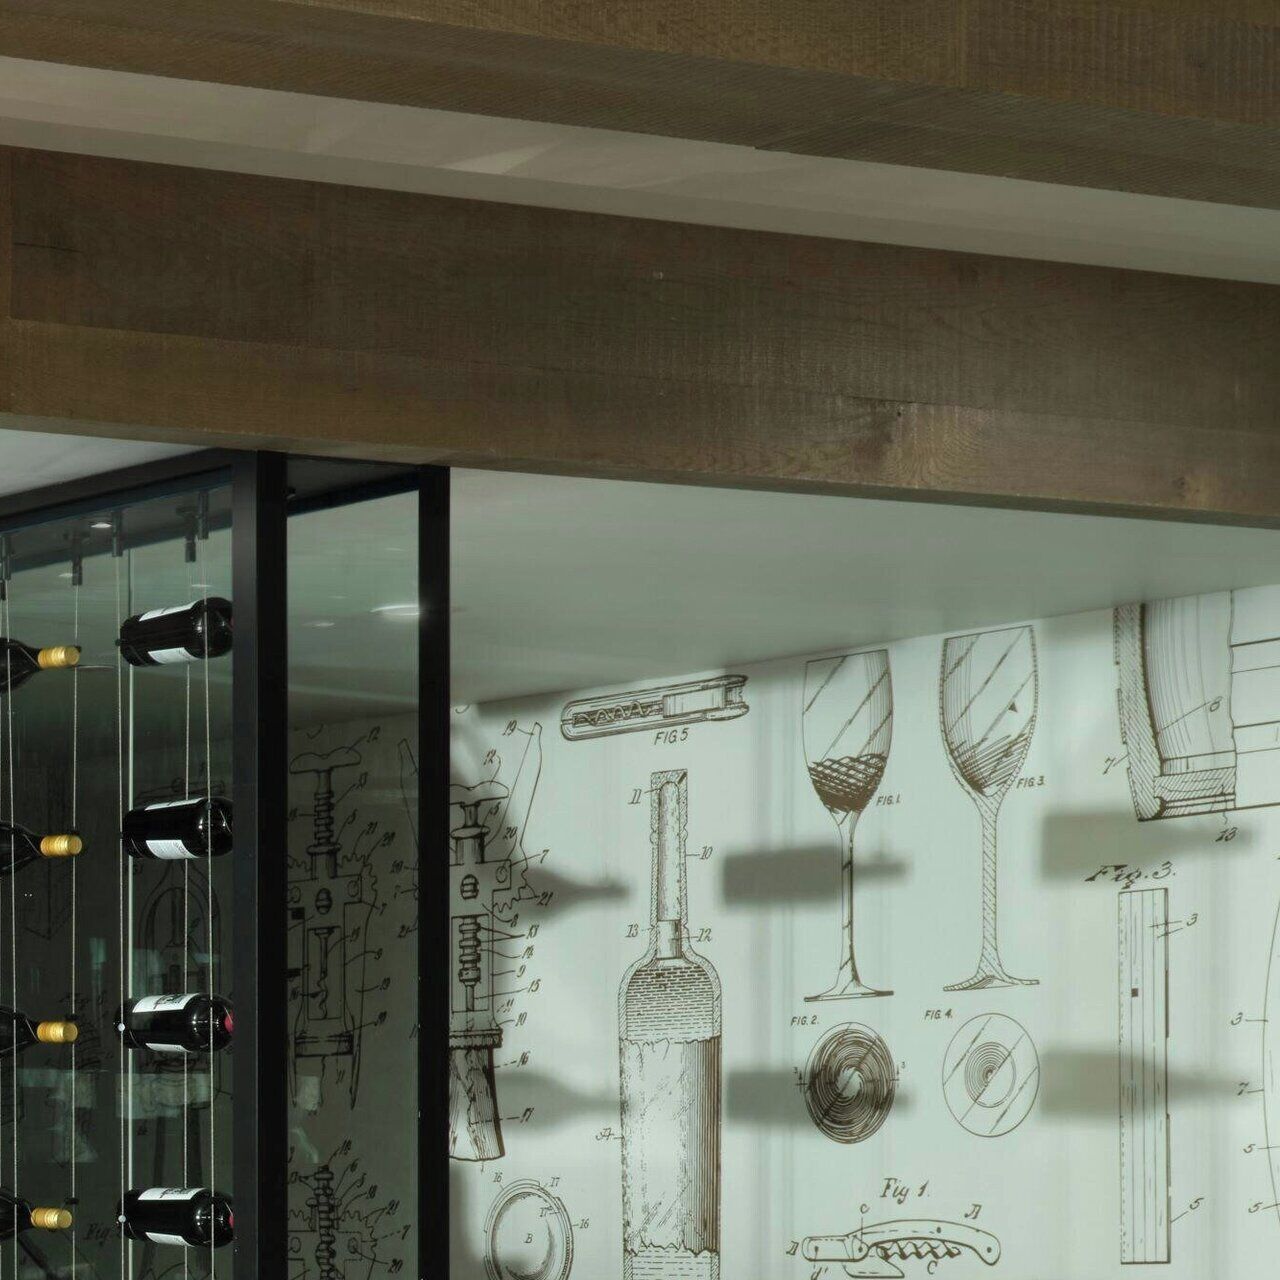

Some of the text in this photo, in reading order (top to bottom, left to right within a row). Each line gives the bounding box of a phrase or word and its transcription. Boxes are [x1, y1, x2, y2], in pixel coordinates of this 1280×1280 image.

[699, 845, 713, 859] 10
[1186, 913, 1199, 926] 3
[625, 924, 639, 938] 13
[697, 928, 712, 942] 12
[1230, 1012, 1243, 1026] 3
[1243, 1142, 1255, 1154] 5
[1190, 1197, 1205, 1210] 5
[1248, 1201, 1263, 1214] 5
[525, 1233, 534, 1244] B
